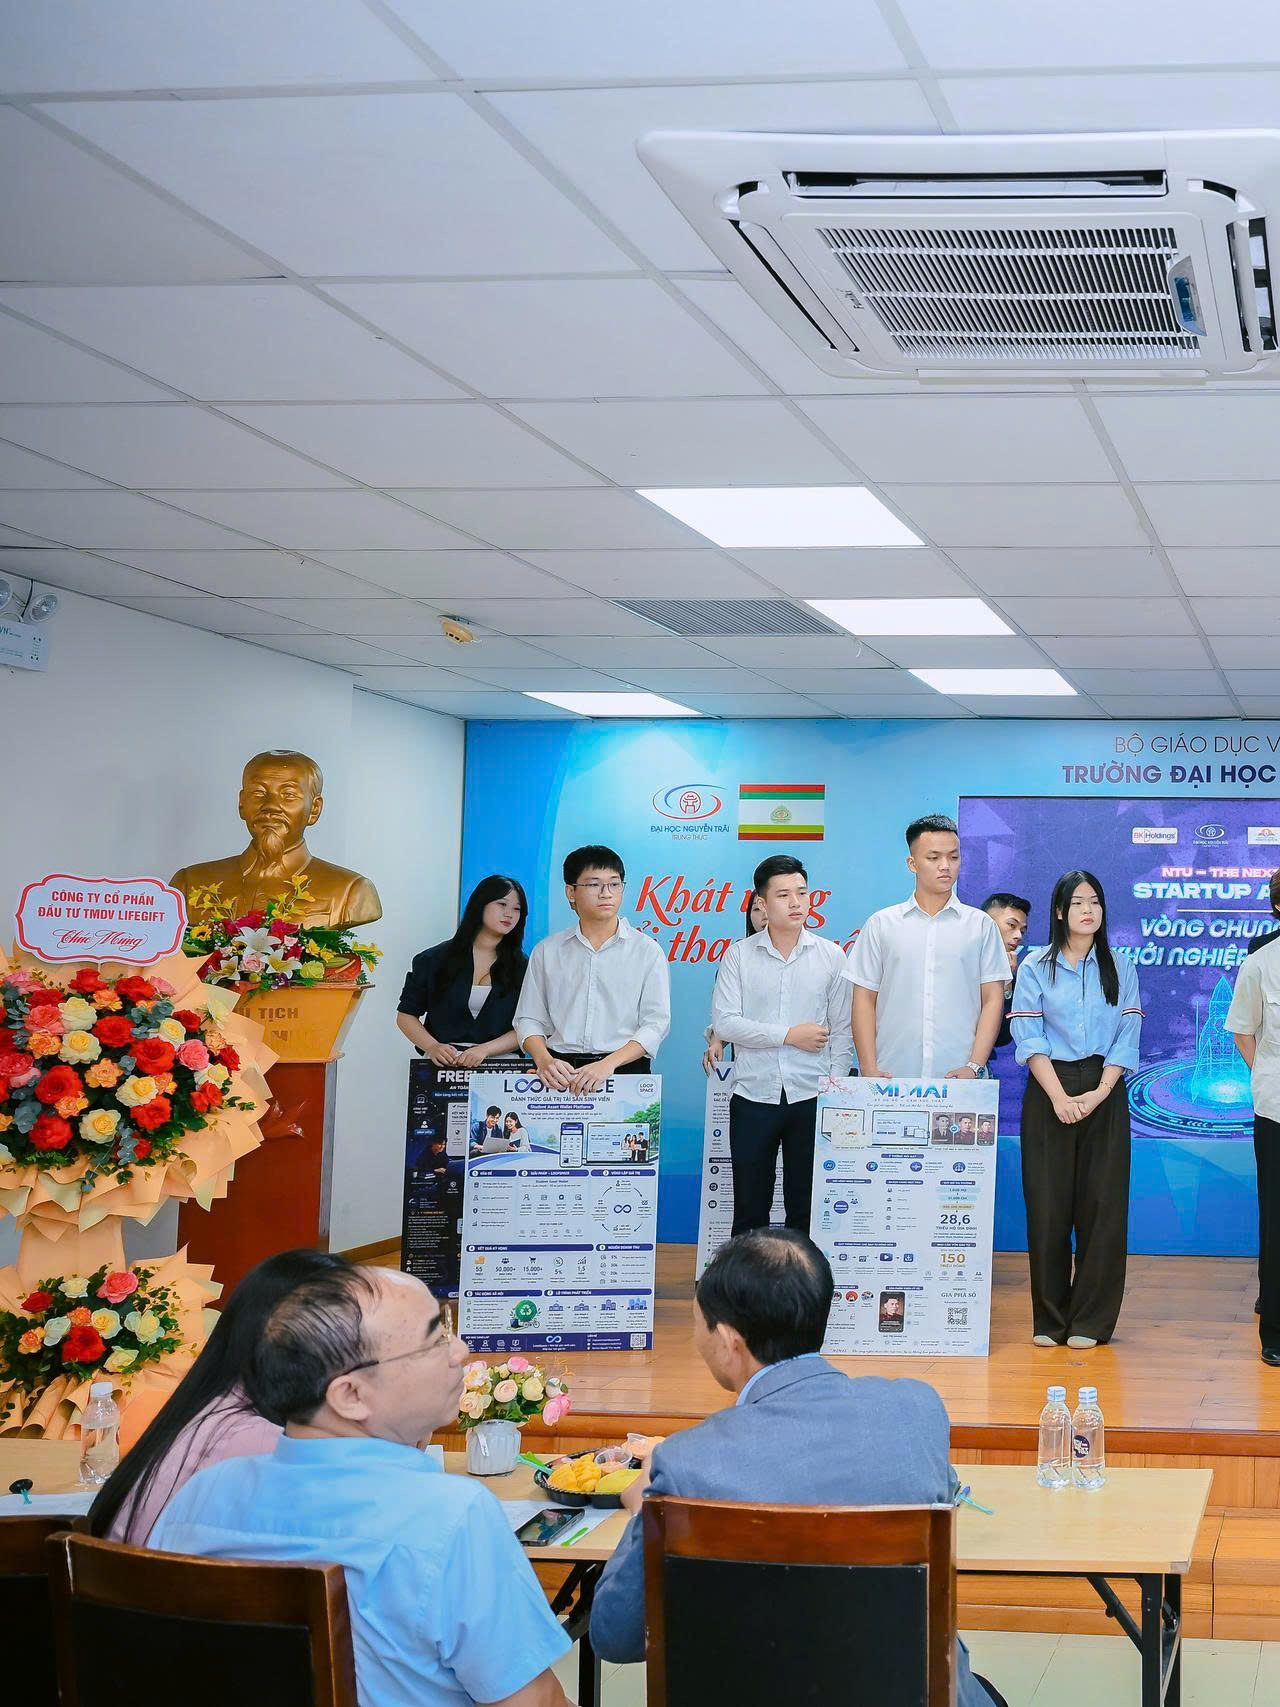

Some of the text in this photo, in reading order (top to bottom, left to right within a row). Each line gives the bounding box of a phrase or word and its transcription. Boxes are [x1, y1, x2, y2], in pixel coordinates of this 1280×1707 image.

[1115, 733, 1144, 757] BỘ
[1151, 733, 1207, 753] GIÁO
[1214, 736, 1259, 757] DỤC
[1062, 760, 1162, 784] TRƯỜNG
[1169, 765, 1212, 789] ĐẠI
[1220, 765, 1277, 789] HỌC
[650, 825, 664, 834] ĐẠI
[664, 825, 681, 834] HỌC
[1162, 867, 1192, 878] NTU
[1209, 868, 1240, 879] THE
[52, 889, 84, 903] CÔNG
[88, 893, 100, 904] TY
[1133, 882, 1252, 900] STARTUP
[635, 874, 734, 927] Khát
[66, 907, 81, 918] TƯ
[83, 908, 115, 920] TMDV
[118, 910, 165, 922] LIFEGIFT
[1140, 914, 1205, 938] VÒNG
[940, 1253, 966, 1264] 150
